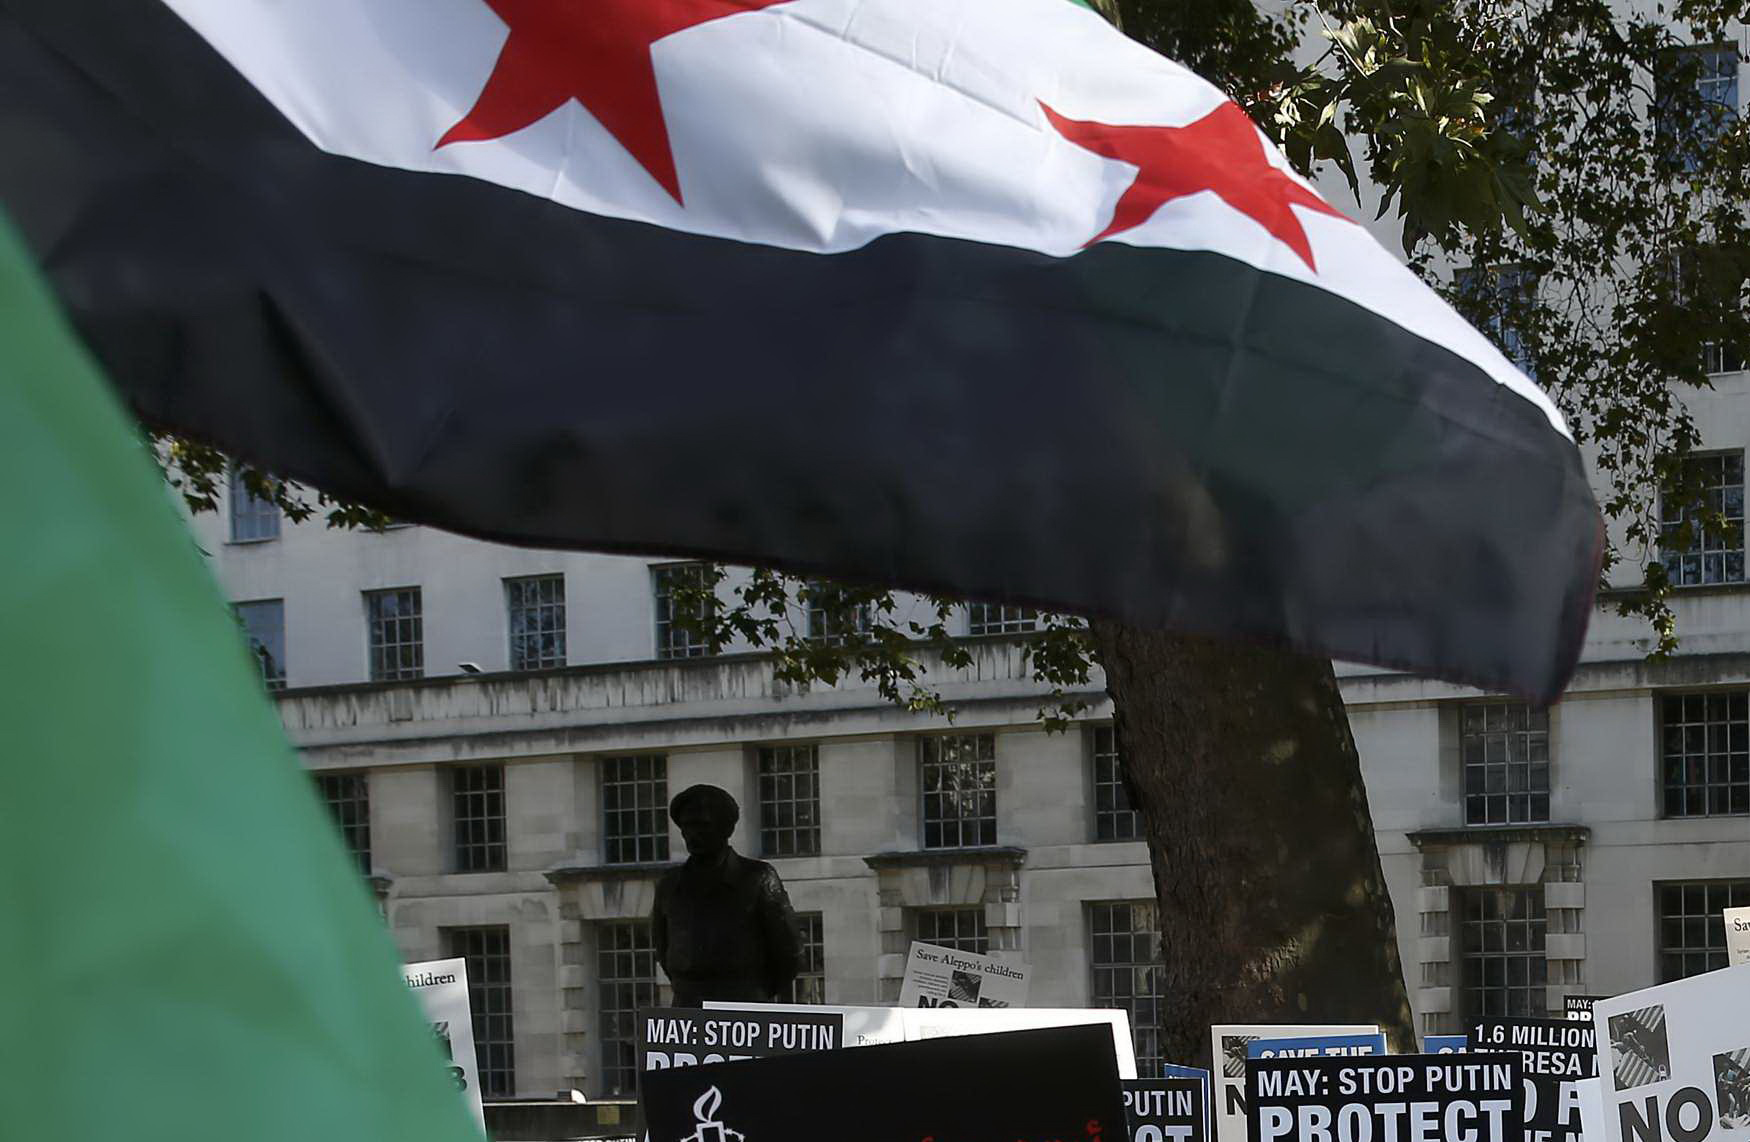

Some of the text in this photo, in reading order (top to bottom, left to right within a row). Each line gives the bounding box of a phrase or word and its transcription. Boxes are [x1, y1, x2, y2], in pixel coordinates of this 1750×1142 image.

[916, 950, 938, 963] Save
[984, 963, 1024, 980] children
[401, 972, 456, 988] hildren
[1567, 999, 1592, 1010] MAY:
[646, 1018, 834, 1050] MAY: STOP PUTIN
[1475, 1024, 1595, 1048] 1.6 MILLION
[1257, 1064, 1512, 1097] MAY: STOP PUTIN
